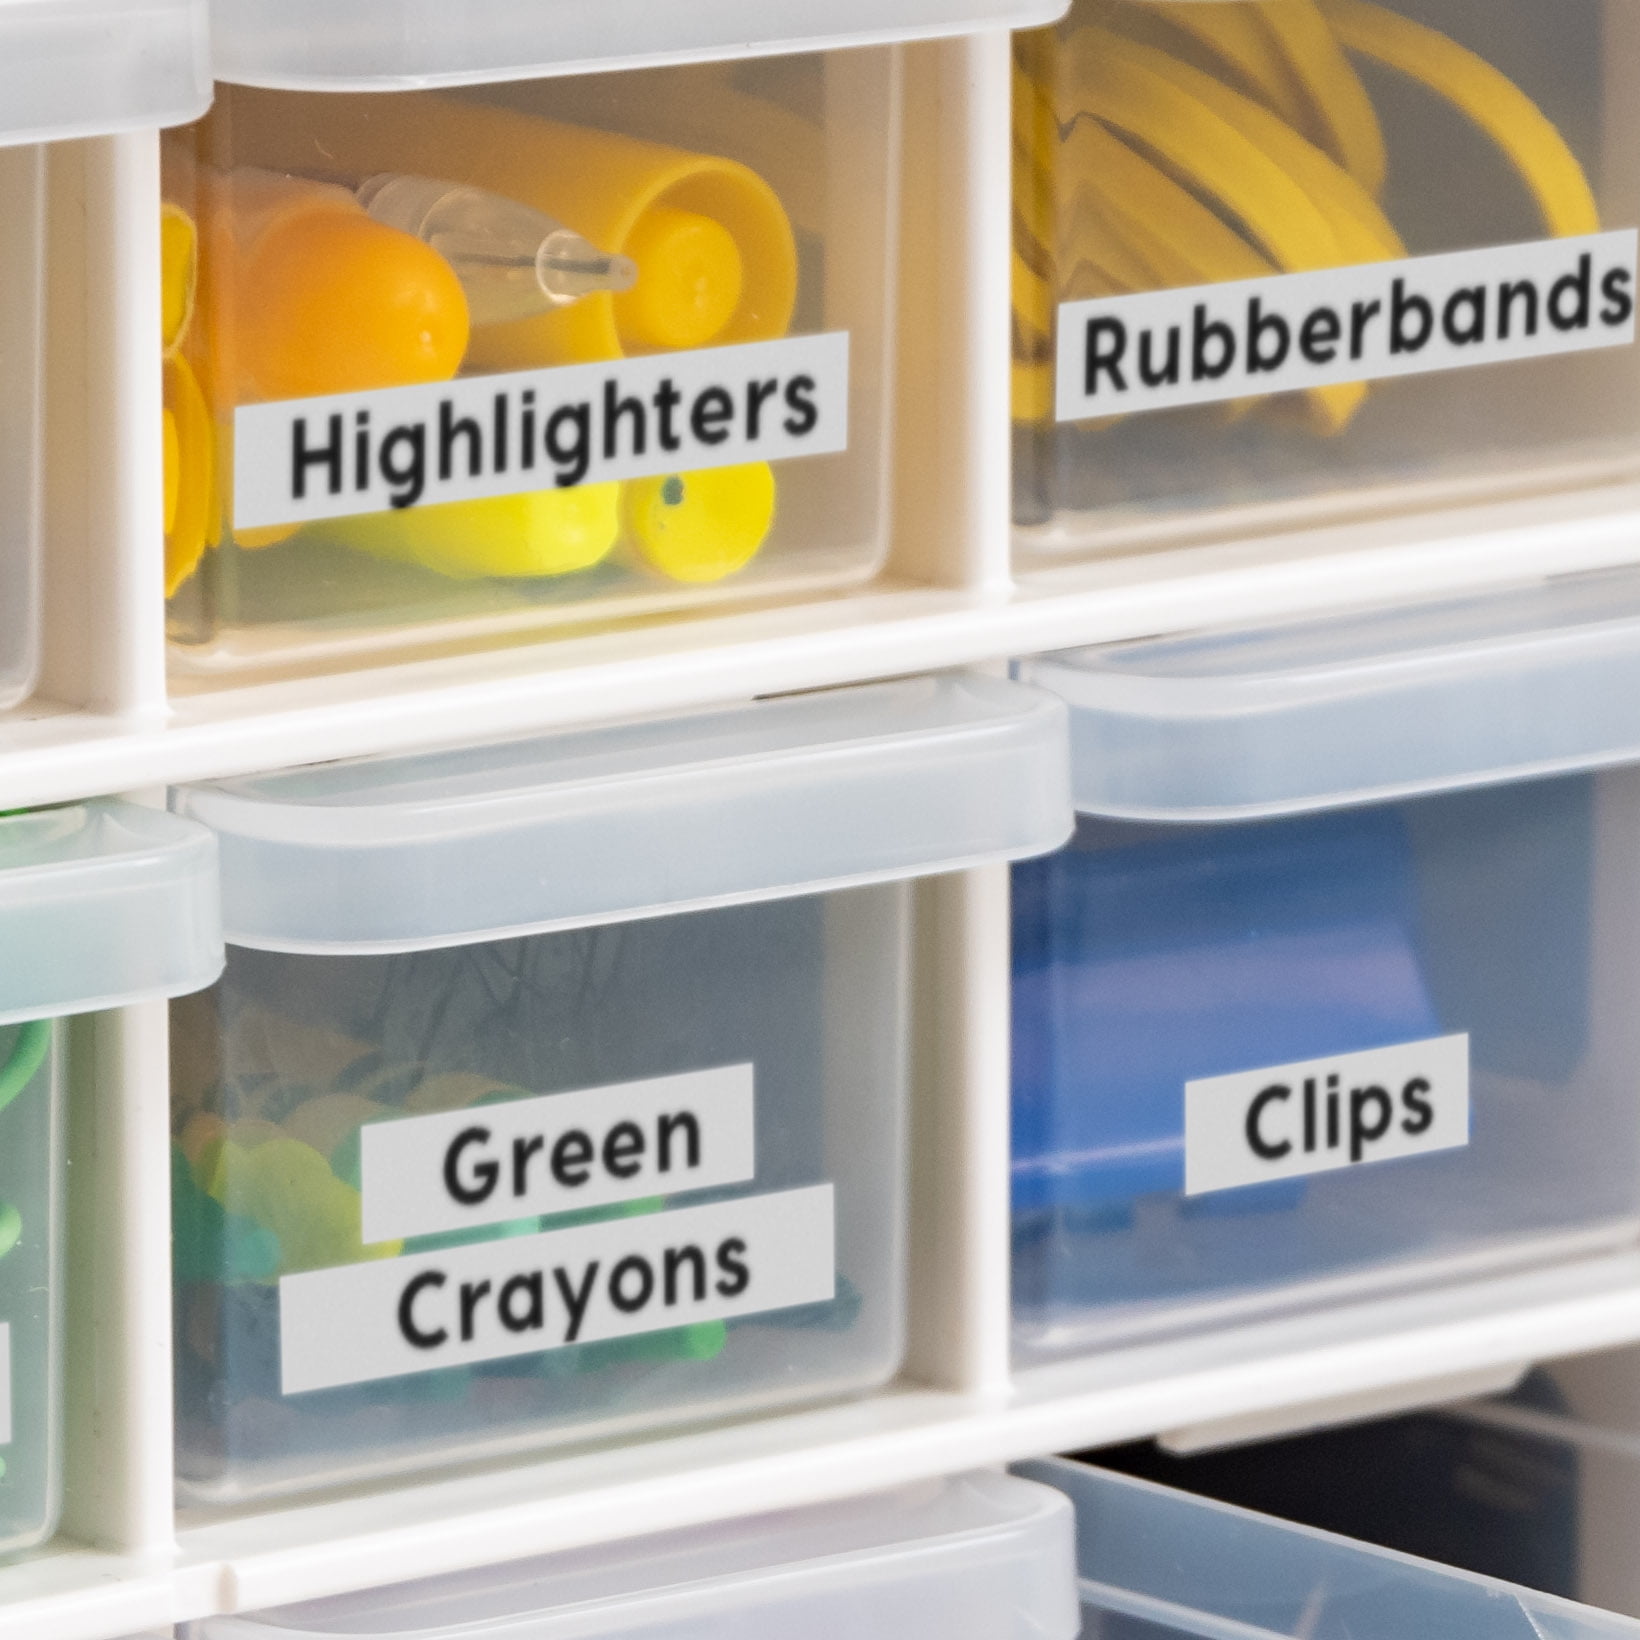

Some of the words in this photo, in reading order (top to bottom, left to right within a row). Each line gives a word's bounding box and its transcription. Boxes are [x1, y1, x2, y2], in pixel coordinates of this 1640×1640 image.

[1084, 252, 1633, 396] Rubberbands
[291, 374, 819, 511] Highlighters
[443, 1110, 700, 1206] Green
[1244, 1073, 1434, 1163] Clips
[397, 1236, 750, 1350] Crayons
